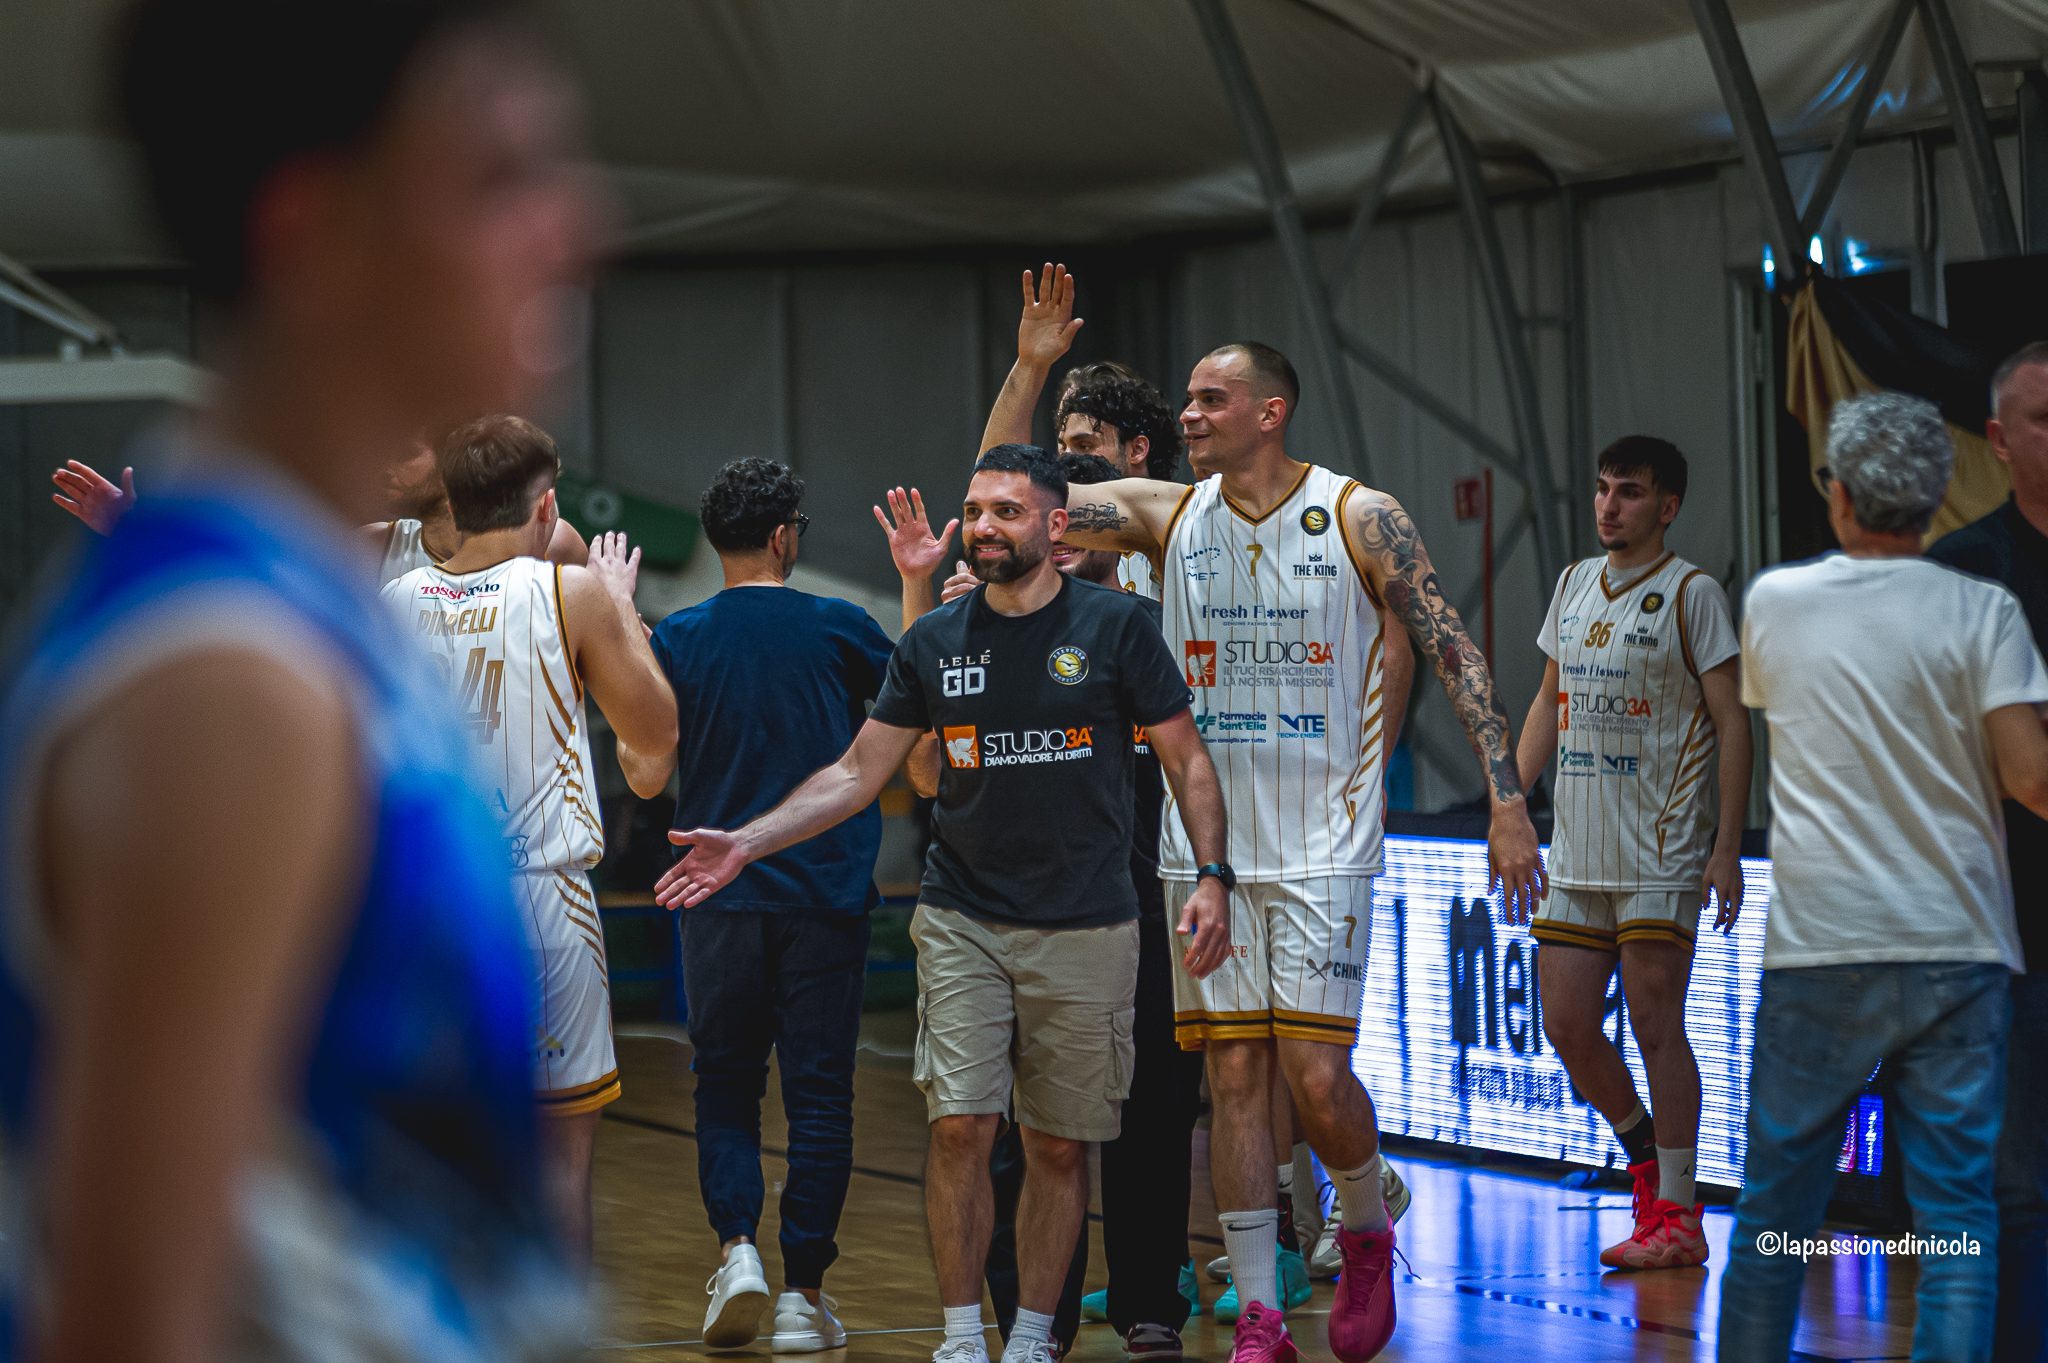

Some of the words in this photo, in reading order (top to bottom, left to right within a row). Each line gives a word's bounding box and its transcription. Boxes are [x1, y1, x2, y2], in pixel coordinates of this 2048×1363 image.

[1246, 544, 1263, 576] 7
[1187, 572, 1219, 581] MET
[1293, 564, 1311, 576] THE
[1314, 564, 1337, 577] KING
[1202, 605, 1248, 619] Fresh
[1584, 620, 1615, 649] 36
[1624, 633, 1638, 645] THE
[1639, 635, 1659, 648] KING
[939, 649, 991, 669] LELÉ
[1223, 666, 1231, 676] IL
[1234, 666, 1256, 676] TUO
[1259, 666, 1334, 677] RISARCIMENTO
[943, 666, 986, 698] GD
[1223, 677, 1236, 687] LA
[1238, 677, 1283, 687] NOSTRA
[1286, 677, 1335, 688] MISSIONE
[1219, 711, 1267, 721] Farmacia
[1277, 714, 1325, 732] VTE
[1219, 721, 1267, 731] Sant'Elia
[984, 727, 1093, 756] STUDIO3A
[984, 754, 1017, 767] DIAMO
[1018, 752, 1053, 764] VALORE
[1054, 751, 1064, 761] AI
[1065, 747, 1093, 760] DIRITTI
[1602, 754, 1639, 772] VTE
[1344, 915, 1358, 949] 7
